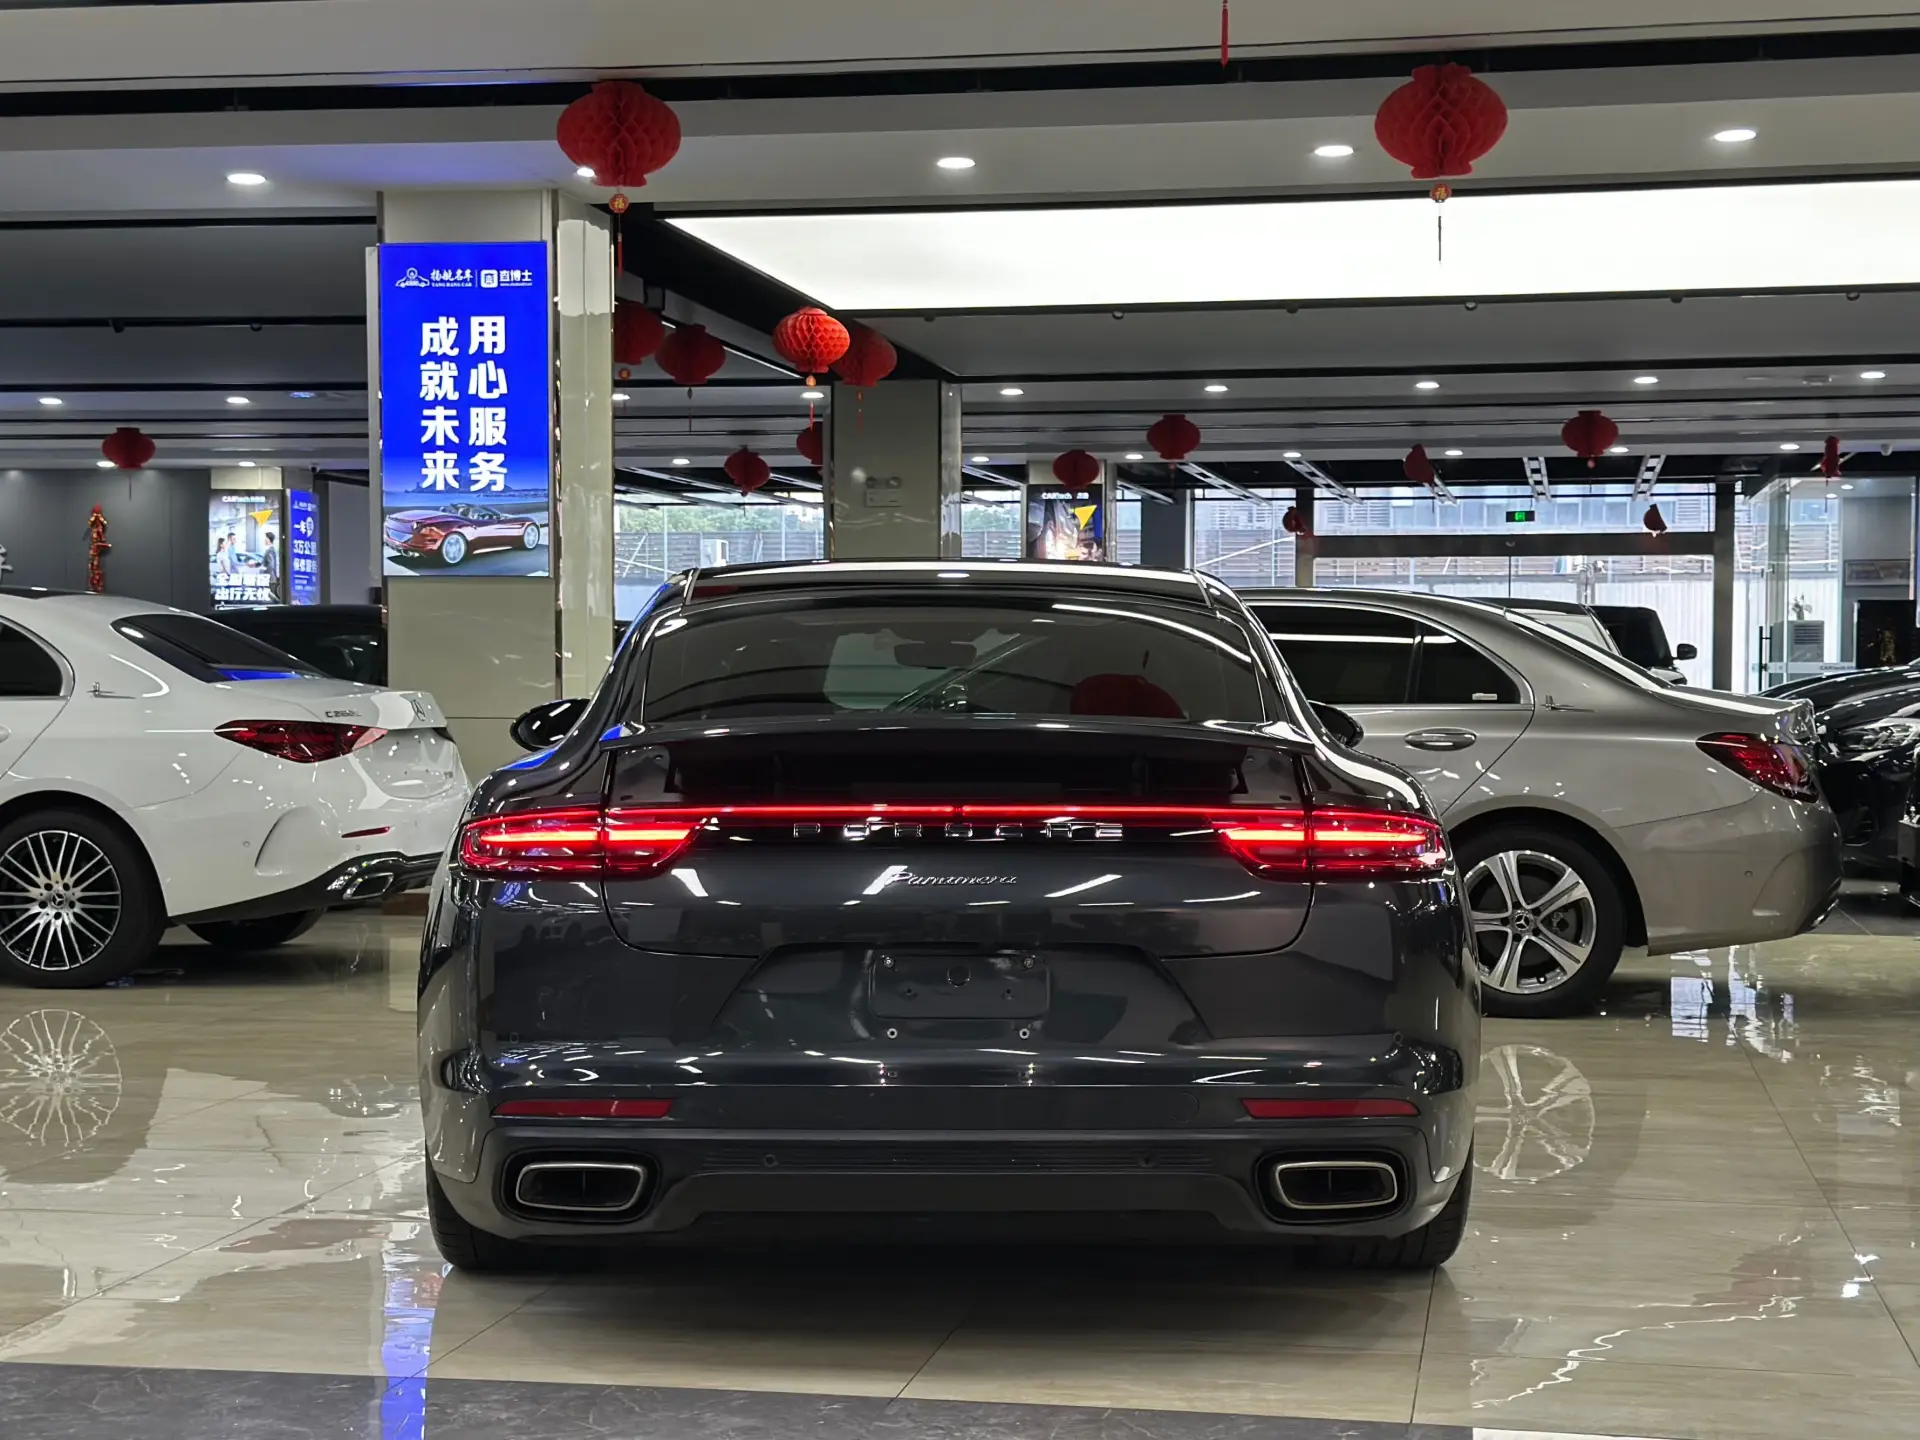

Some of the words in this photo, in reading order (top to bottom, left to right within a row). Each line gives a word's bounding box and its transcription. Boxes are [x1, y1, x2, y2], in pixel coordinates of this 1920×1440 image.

[613, 197, 625, 209] 福
[420, 316, 459, 491] 成就未来
[468, 315, 507, 492] 用心服务
[215, 587, 271, 601] 出行无忧
[793, 822, 1123, 838] PORSCHE
[884, 871, 1017, 885] Panamera
